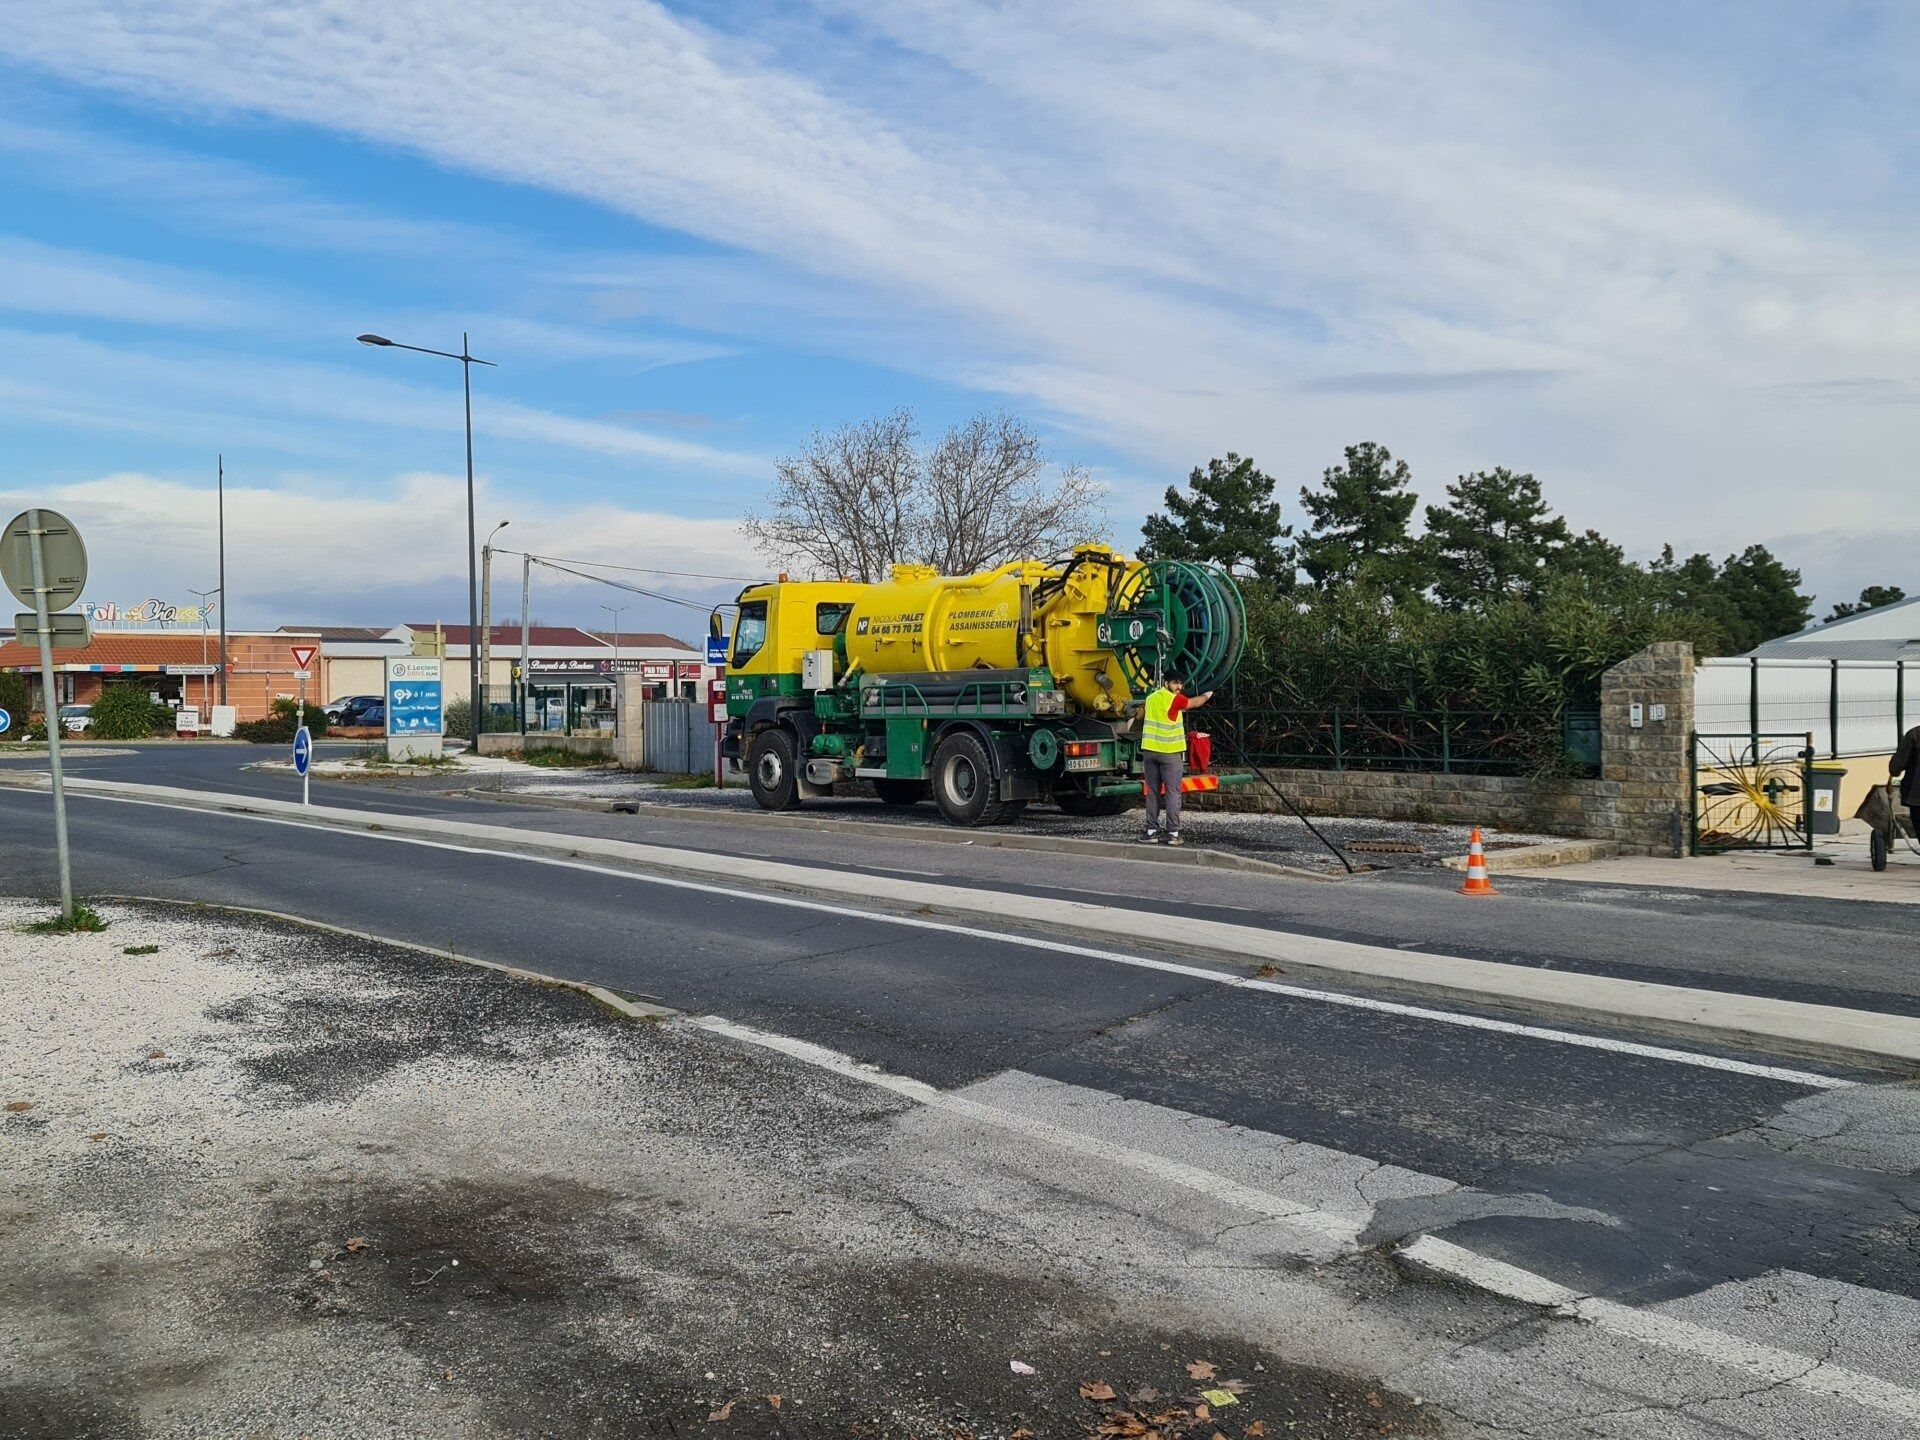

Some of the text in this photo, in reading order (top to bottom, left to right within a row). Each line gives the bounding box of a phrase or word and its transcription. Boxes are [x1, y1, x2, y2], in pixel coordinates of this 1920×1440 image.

[948, 610, 994, 620] PLOMBERIE
[871, 626, 880, 635] 04
[892, 625, 901, 634] 73
[902, 625, 912, 633] 70
[912, 624, 923, 633] 22
[949, 620, 1018, 631] ASSAINISSEMENT
